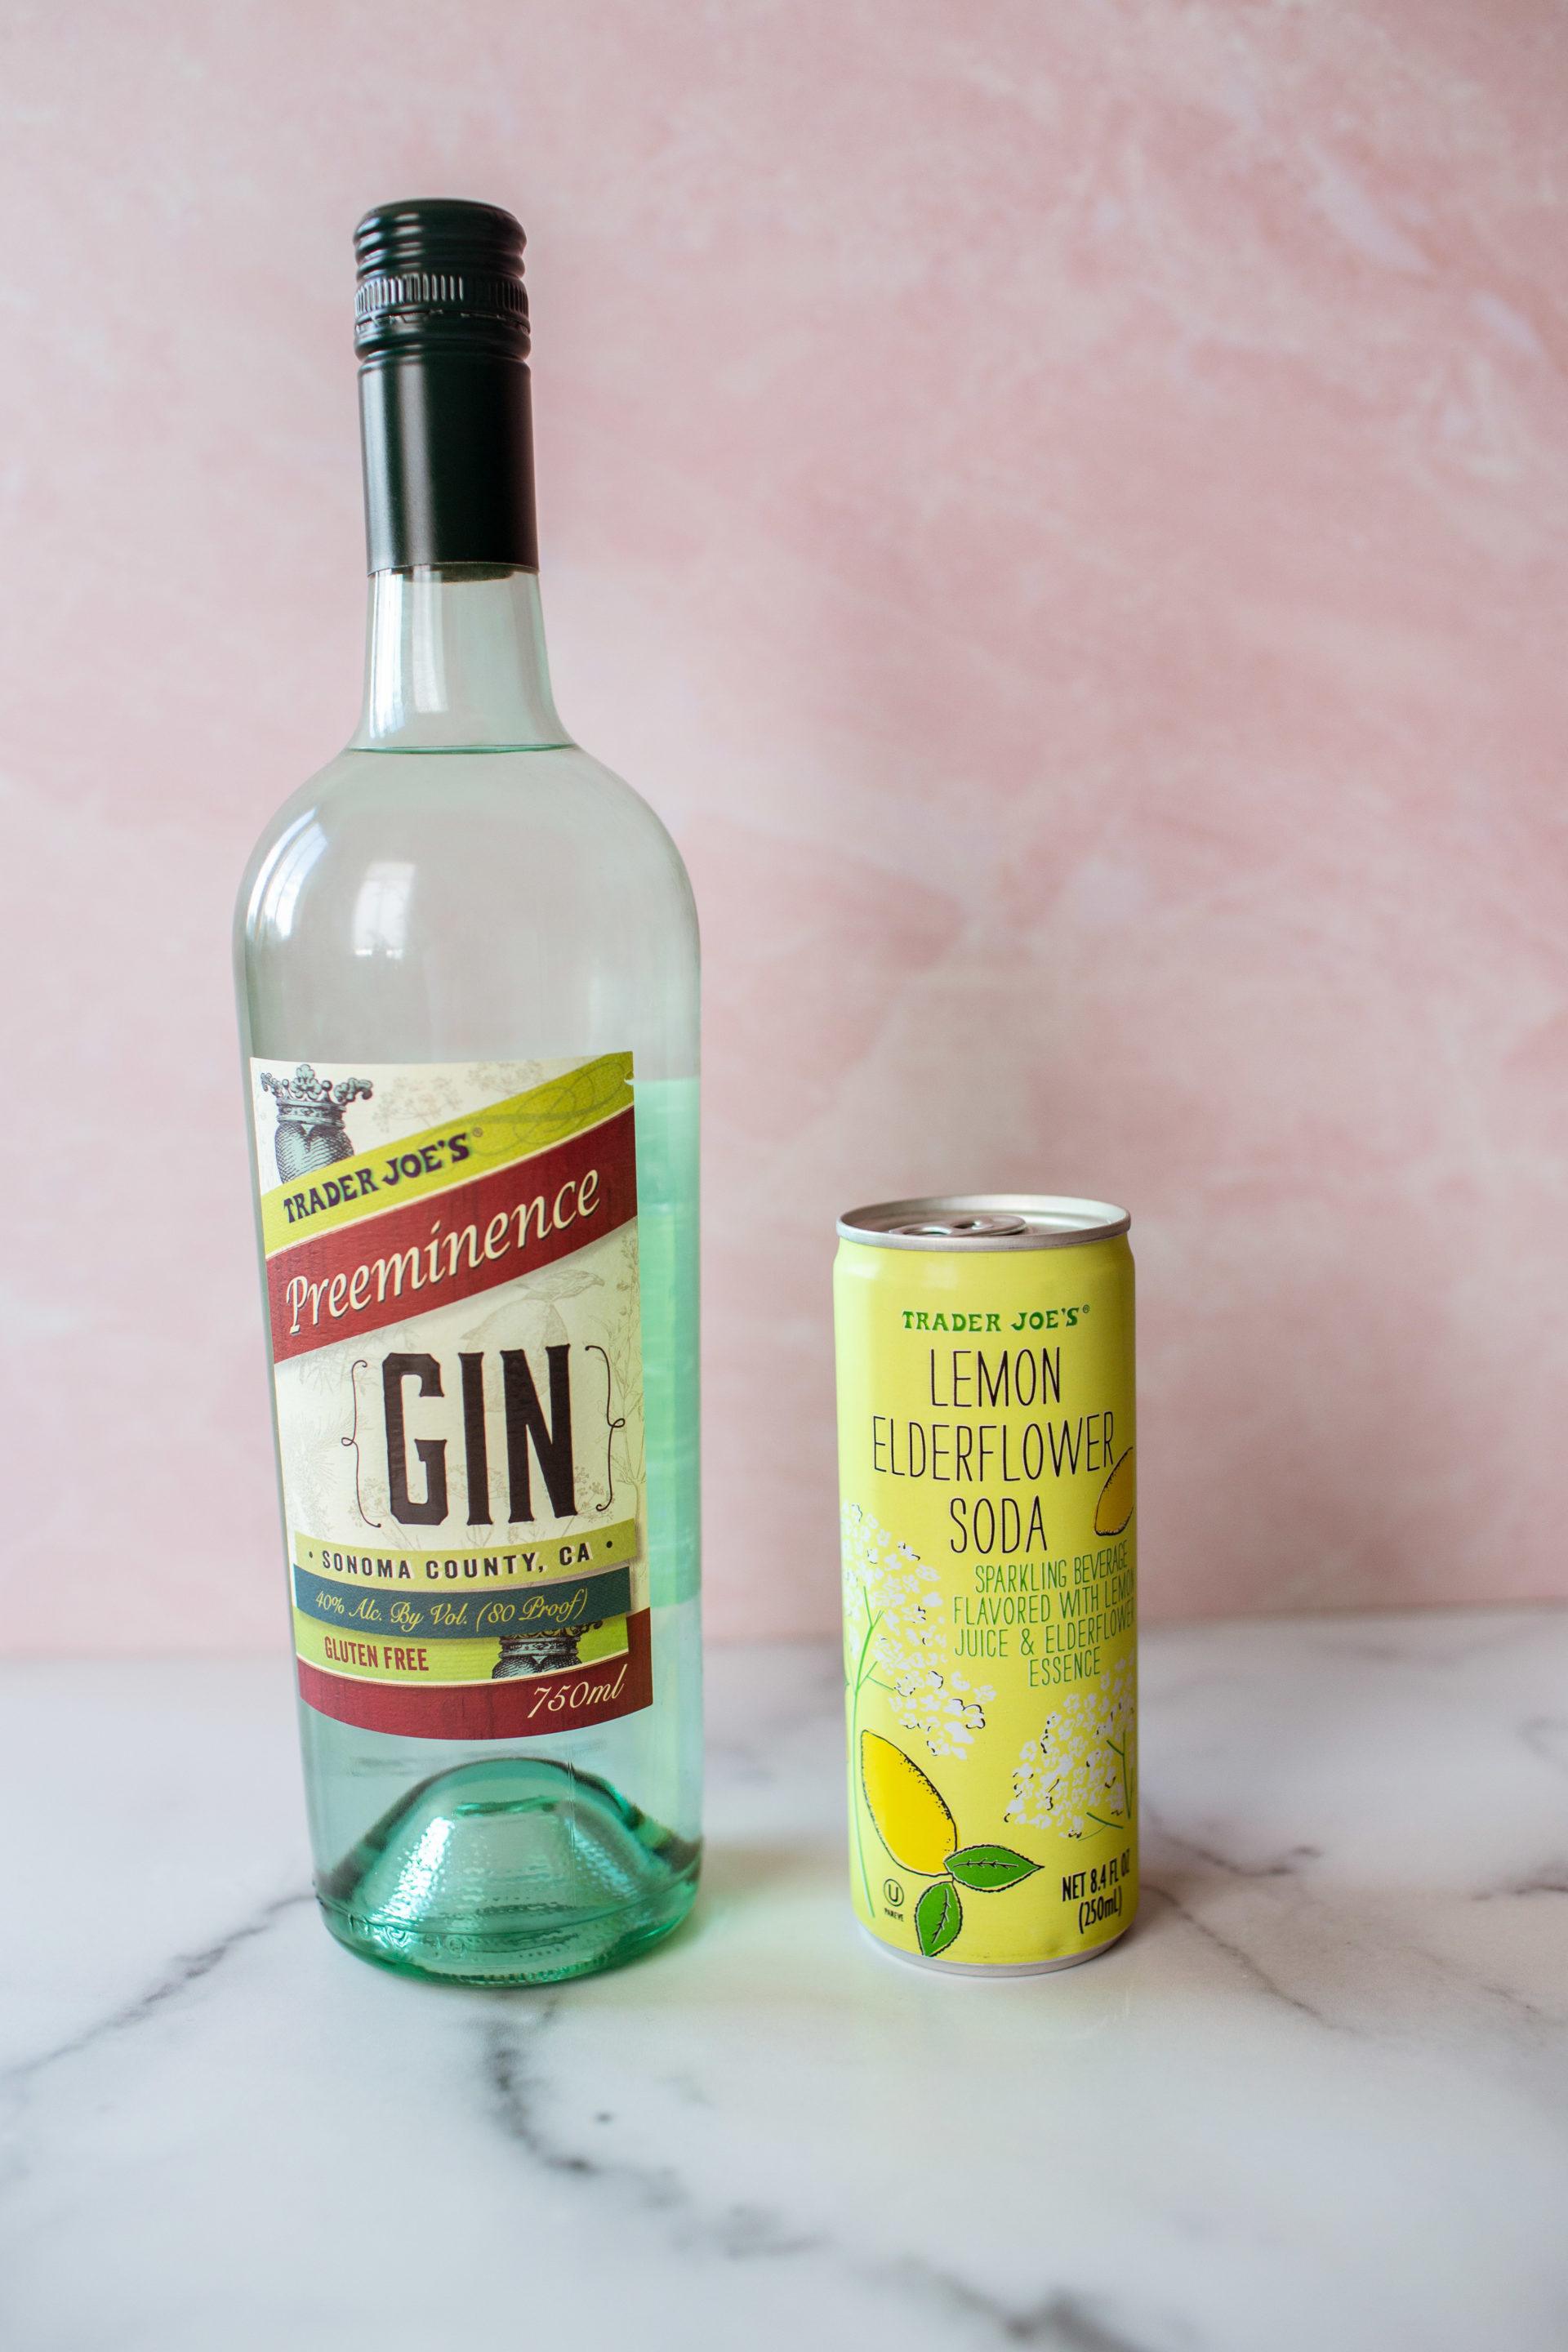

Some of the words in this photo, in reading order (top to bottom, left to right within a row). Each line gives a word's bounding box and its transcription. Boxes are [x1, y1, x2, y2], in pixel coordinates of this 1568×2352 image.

[283, 1167, 380, 1223] TRADER
[286, 1169, 600, 1334] Preeminence
[902, 1310, 1001, 1332] TRADER
[930, 1347, 1060, 1407] LEMON
[381, 1343, 577, 1526] GIN
[873, 1411, 1114, 1481] ELDERFLOWER
[950, 1495, 1048, 1553] SODA
[323, 1550, 412, 1579] SONOMA
[425, 1552, 545, 1580] COUNTY,
[559, 1541, 592, 1566] CA
[974, 1559, 1067, 1593] SPARKLING
[1074, 1539, 1128, 1584] BEVERAGE
[315, 1590, 345, 1615] 40%
[349, 1598, 383, 1622] Alc.
[390, 1601, 424, 1633] By
[430, 1602, 468, 1626] Vol.
[476, 1601, 515, 1633] (80
[519, 1588, 589, 1622] Proof)
[954, 1594, 1051, 1625] FLAVORED
[1059, 1584, 1099, 1619] WITH
[324, 1636, 379, 1668] GLUTEN
[383, 1646, 430, 1672] FREE
[954, 1628, 1009, 1657] JUICE
[1020, 1628, 1035, 1656] &
[1029, 1646, 1102, 1687] ESSENCE
[528, 1664, 628, 1718] 750ml
[1062, 1871, 1087, 1902] NET
[1090, 1864, 1107, 1894] 8.4
[1109, 1857, 1120, 1886] FL
